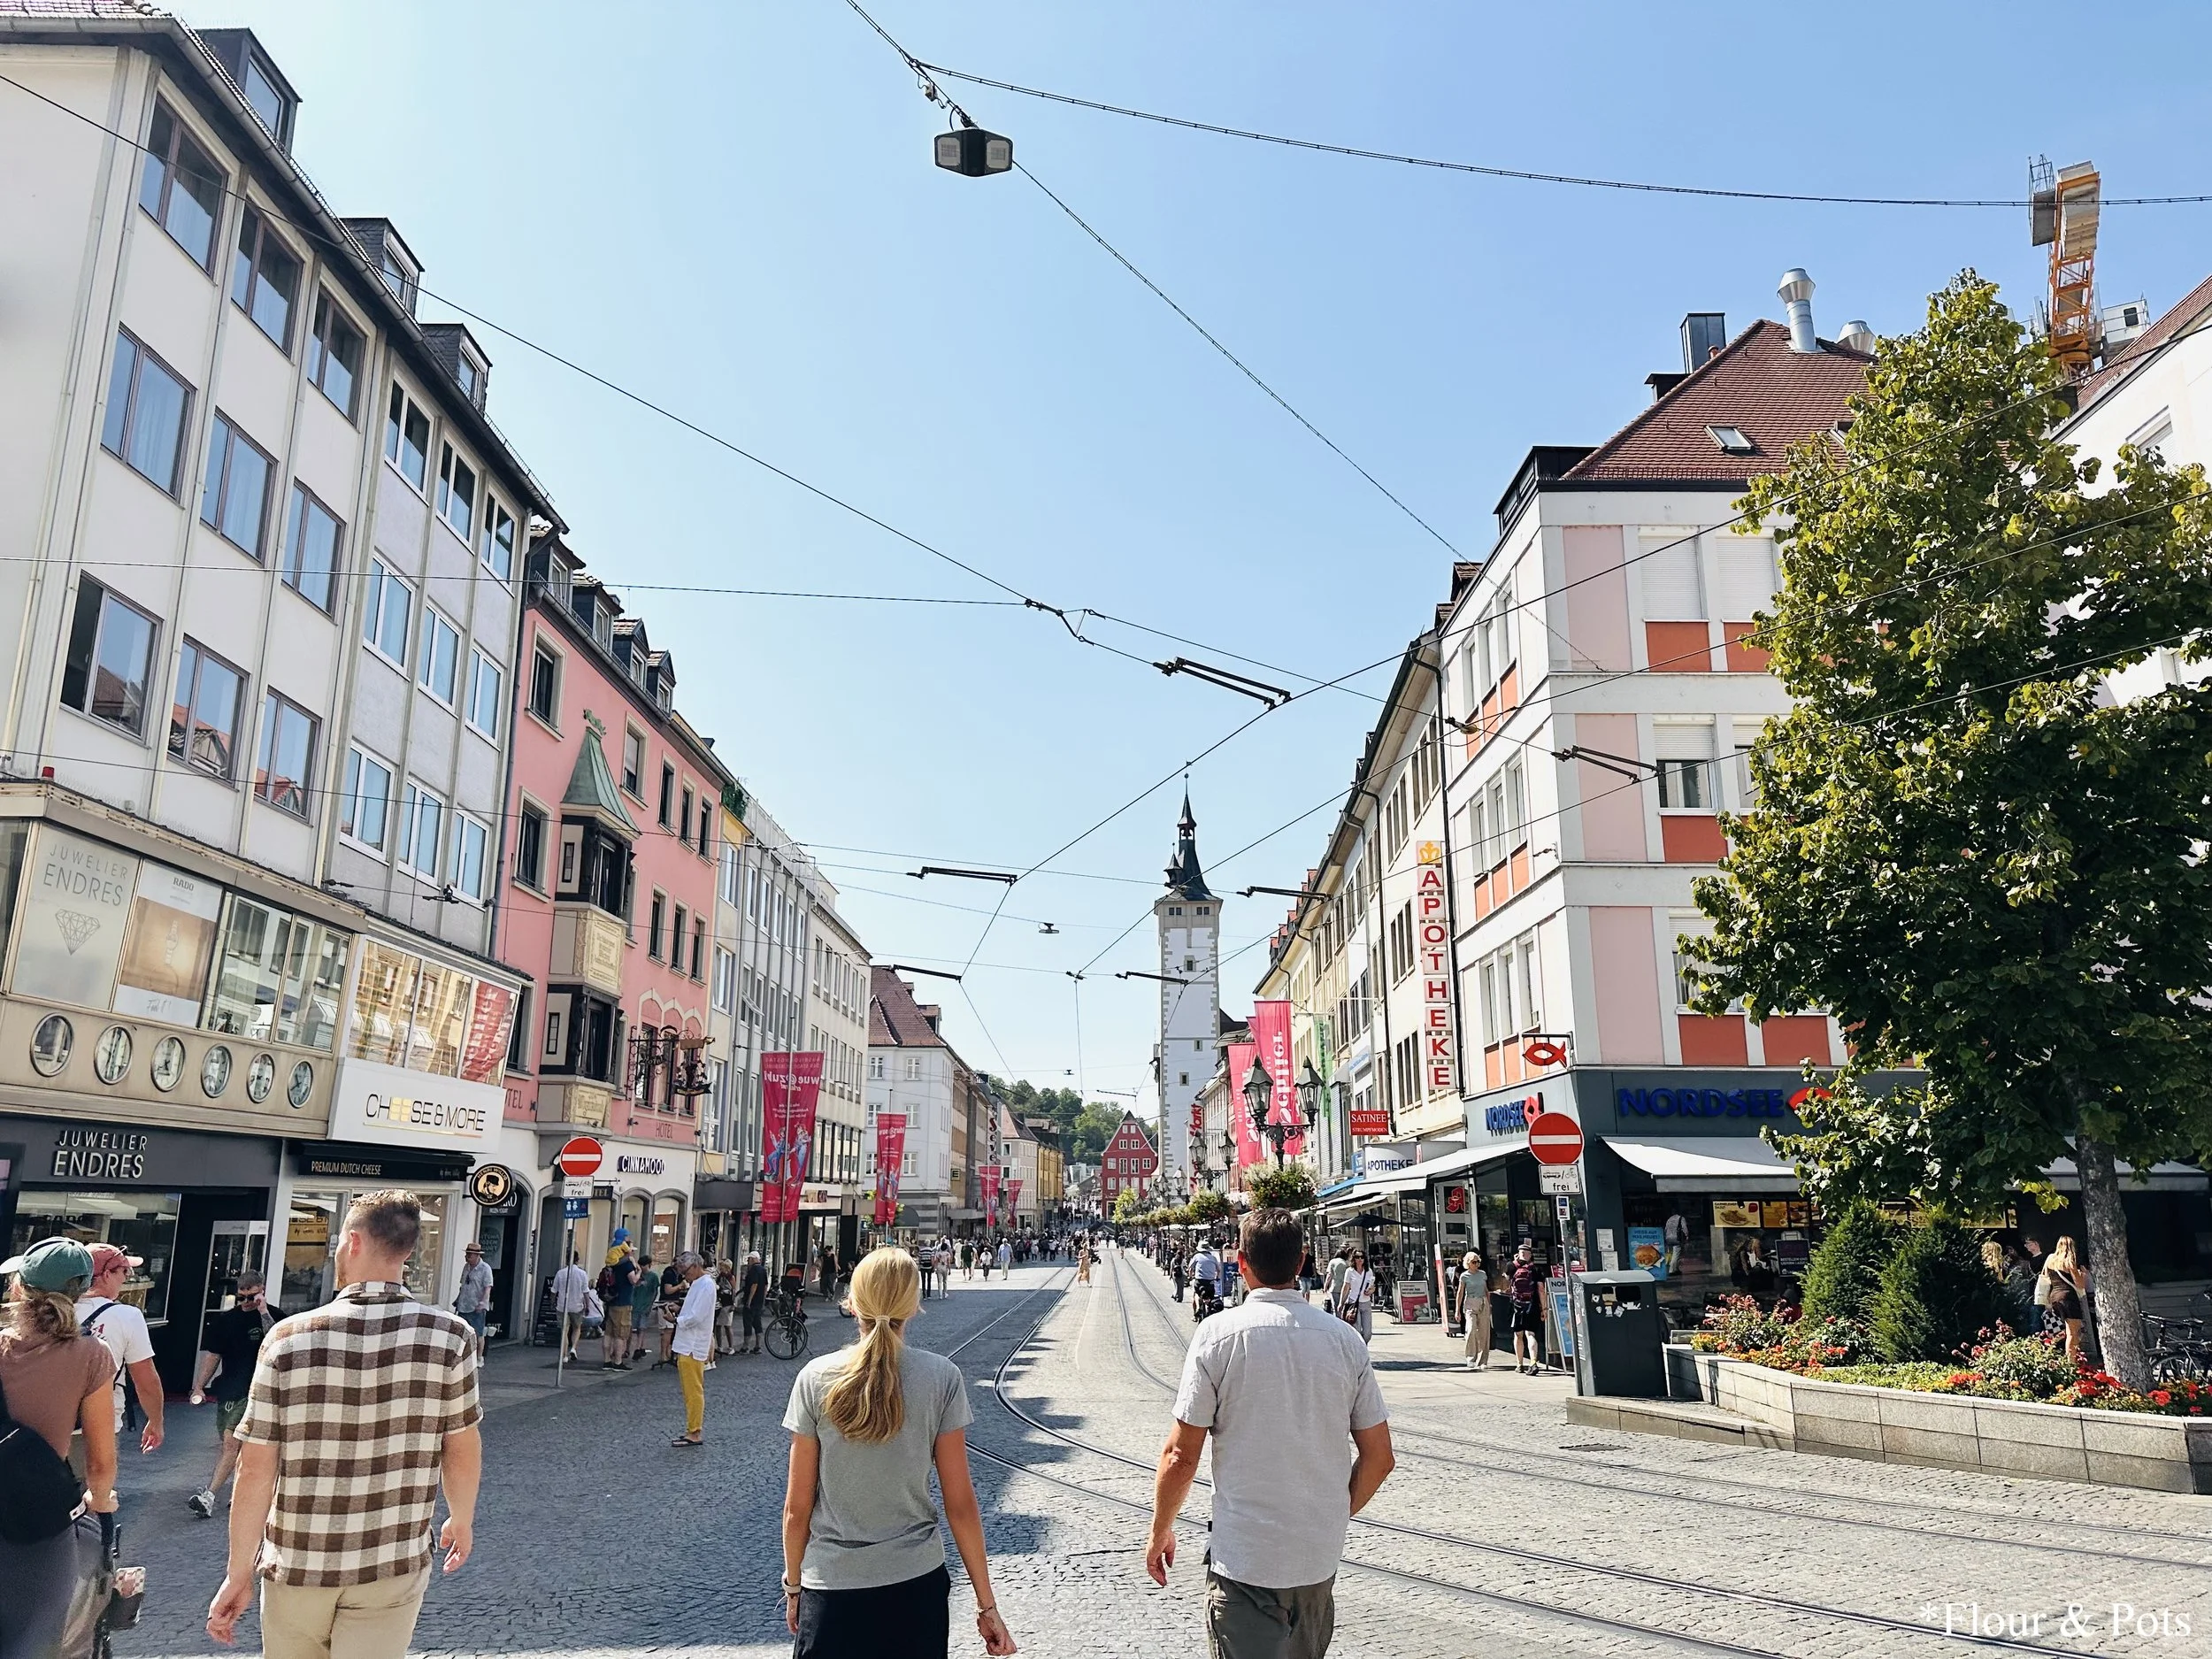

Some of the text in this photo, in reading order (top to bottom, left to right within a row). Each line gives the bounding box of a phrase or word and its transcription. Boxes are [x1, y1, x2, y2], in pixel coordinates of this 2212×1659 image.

[49, 843, 128, 879] JUWELIER
[43, 863, 123, 907] ENDRES
[173, 877, 195, 891] RADO
[1422, 870, 1451, 1086] APOTHEKE
[1486, 1100, 1525, 1130] NORDSEE
[1617, 1087, 1785, 1118] NORDSEE
[434, 1104, 443, 1125] &
[445, 1105, 486, 1131] MORE
[656, 1122, 673, 1140] HOTEL
[1351, 1114, 1387, 1123] SATINEE
[58, 1130, 148, 1150] JUWELIER
[53, 1150, 144, 1179] ENDRES
[311, 1161, 381, 1175] PREMIUM DUTCH CHEESE
[1553, 1182, 1570, 1191] frei
